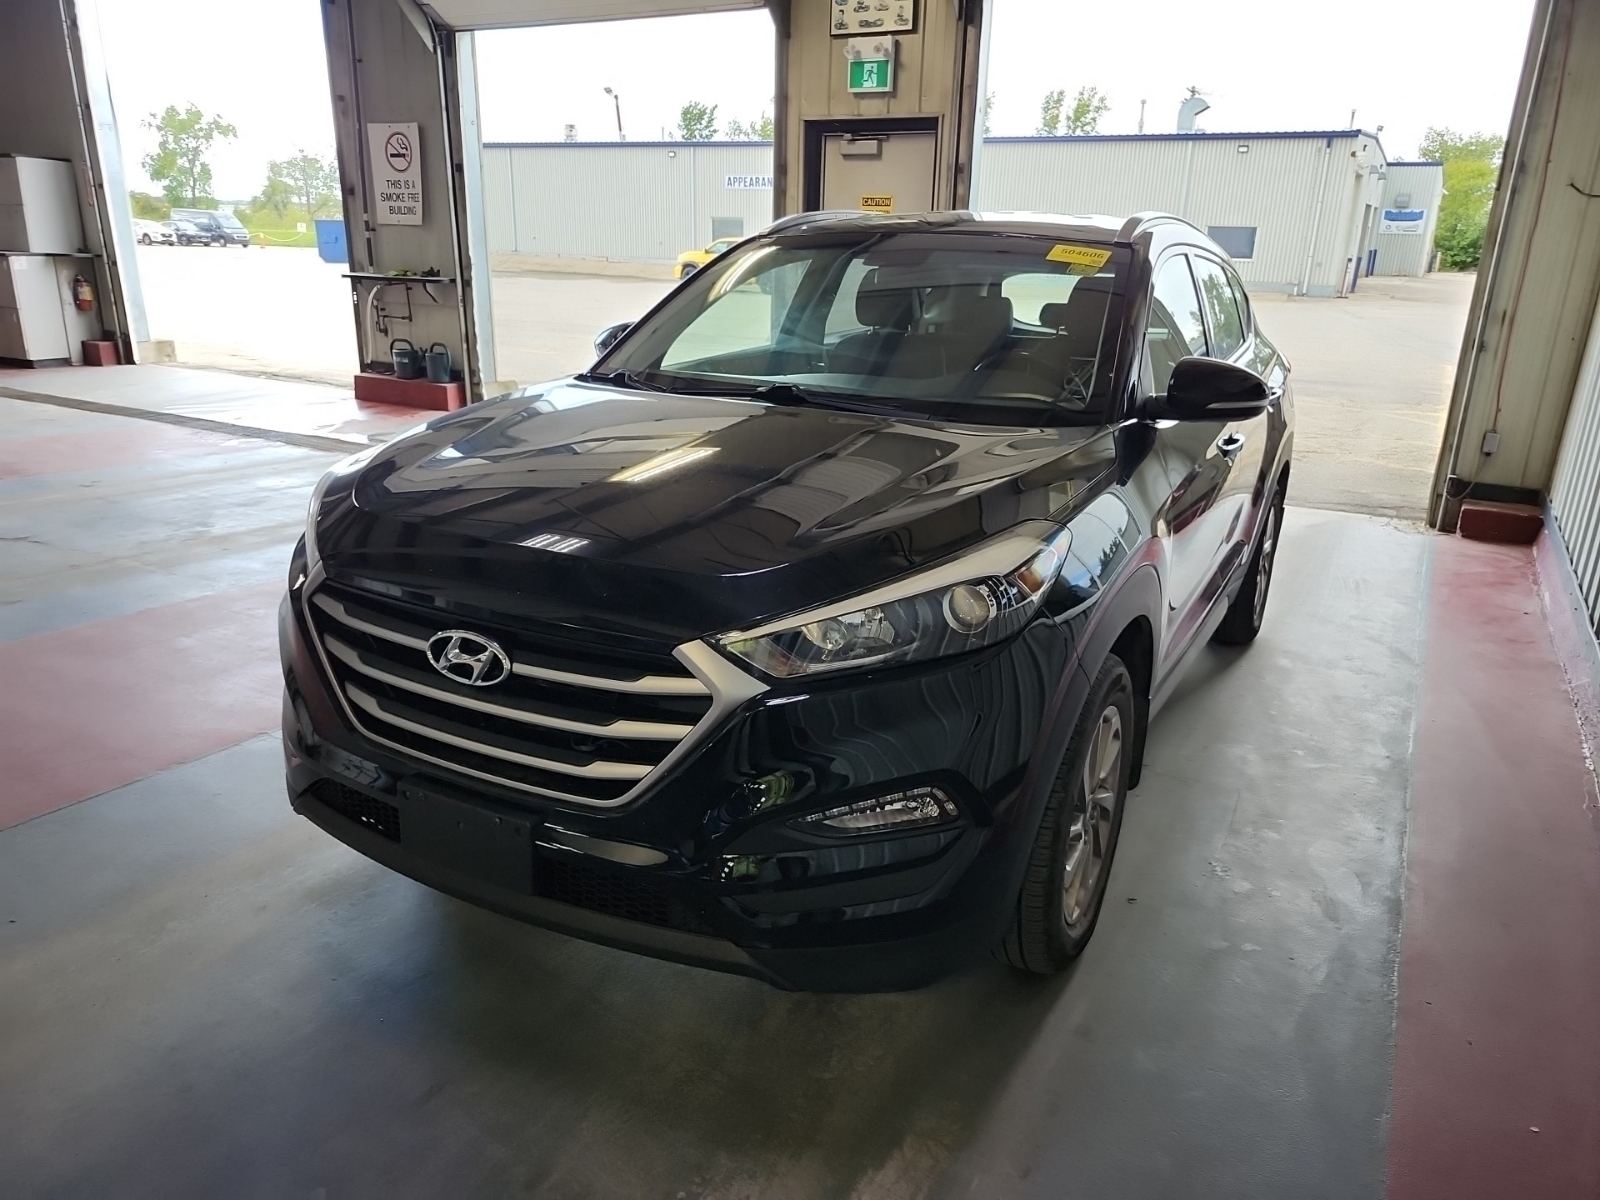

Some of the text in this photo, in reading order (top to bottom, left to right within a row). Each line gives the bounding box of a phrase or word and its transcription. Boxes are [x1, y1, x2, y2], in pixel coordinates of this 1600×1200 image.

[385, 179, 403, 190] THIS
[404, 179, 411, 190] IS
[726, 176, 773, 188] APPEARAN
[380, 192, 420, 203] SMOKE FREE
[863, 198, 890, 206] CAUTION
[389, 206, 417, 216] BUILDING
